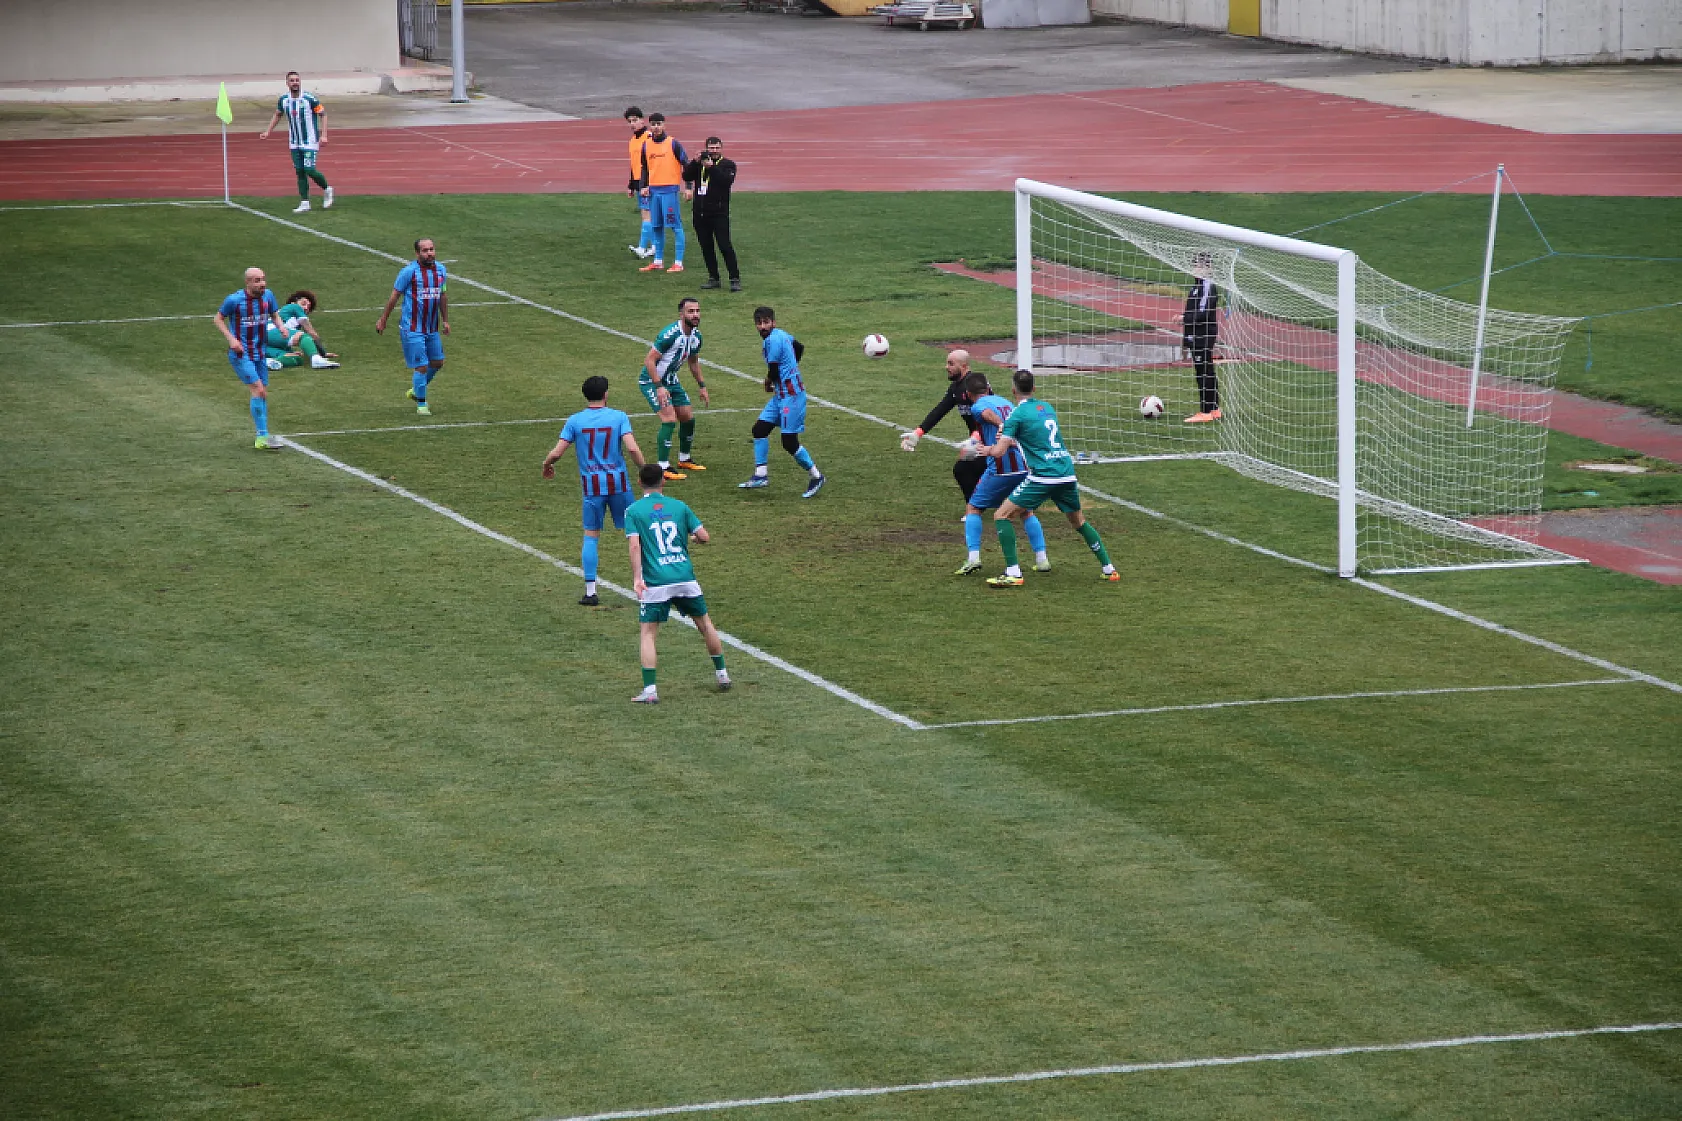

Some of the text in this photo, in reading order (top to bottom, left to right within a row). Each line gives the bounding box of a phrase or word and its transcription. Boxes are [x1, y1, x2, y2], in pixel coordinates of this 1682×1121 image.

[581, 426, 612, 460] 77
[1044, 419, 1061, 449] 2
[648, 521, 682, 554] 12
